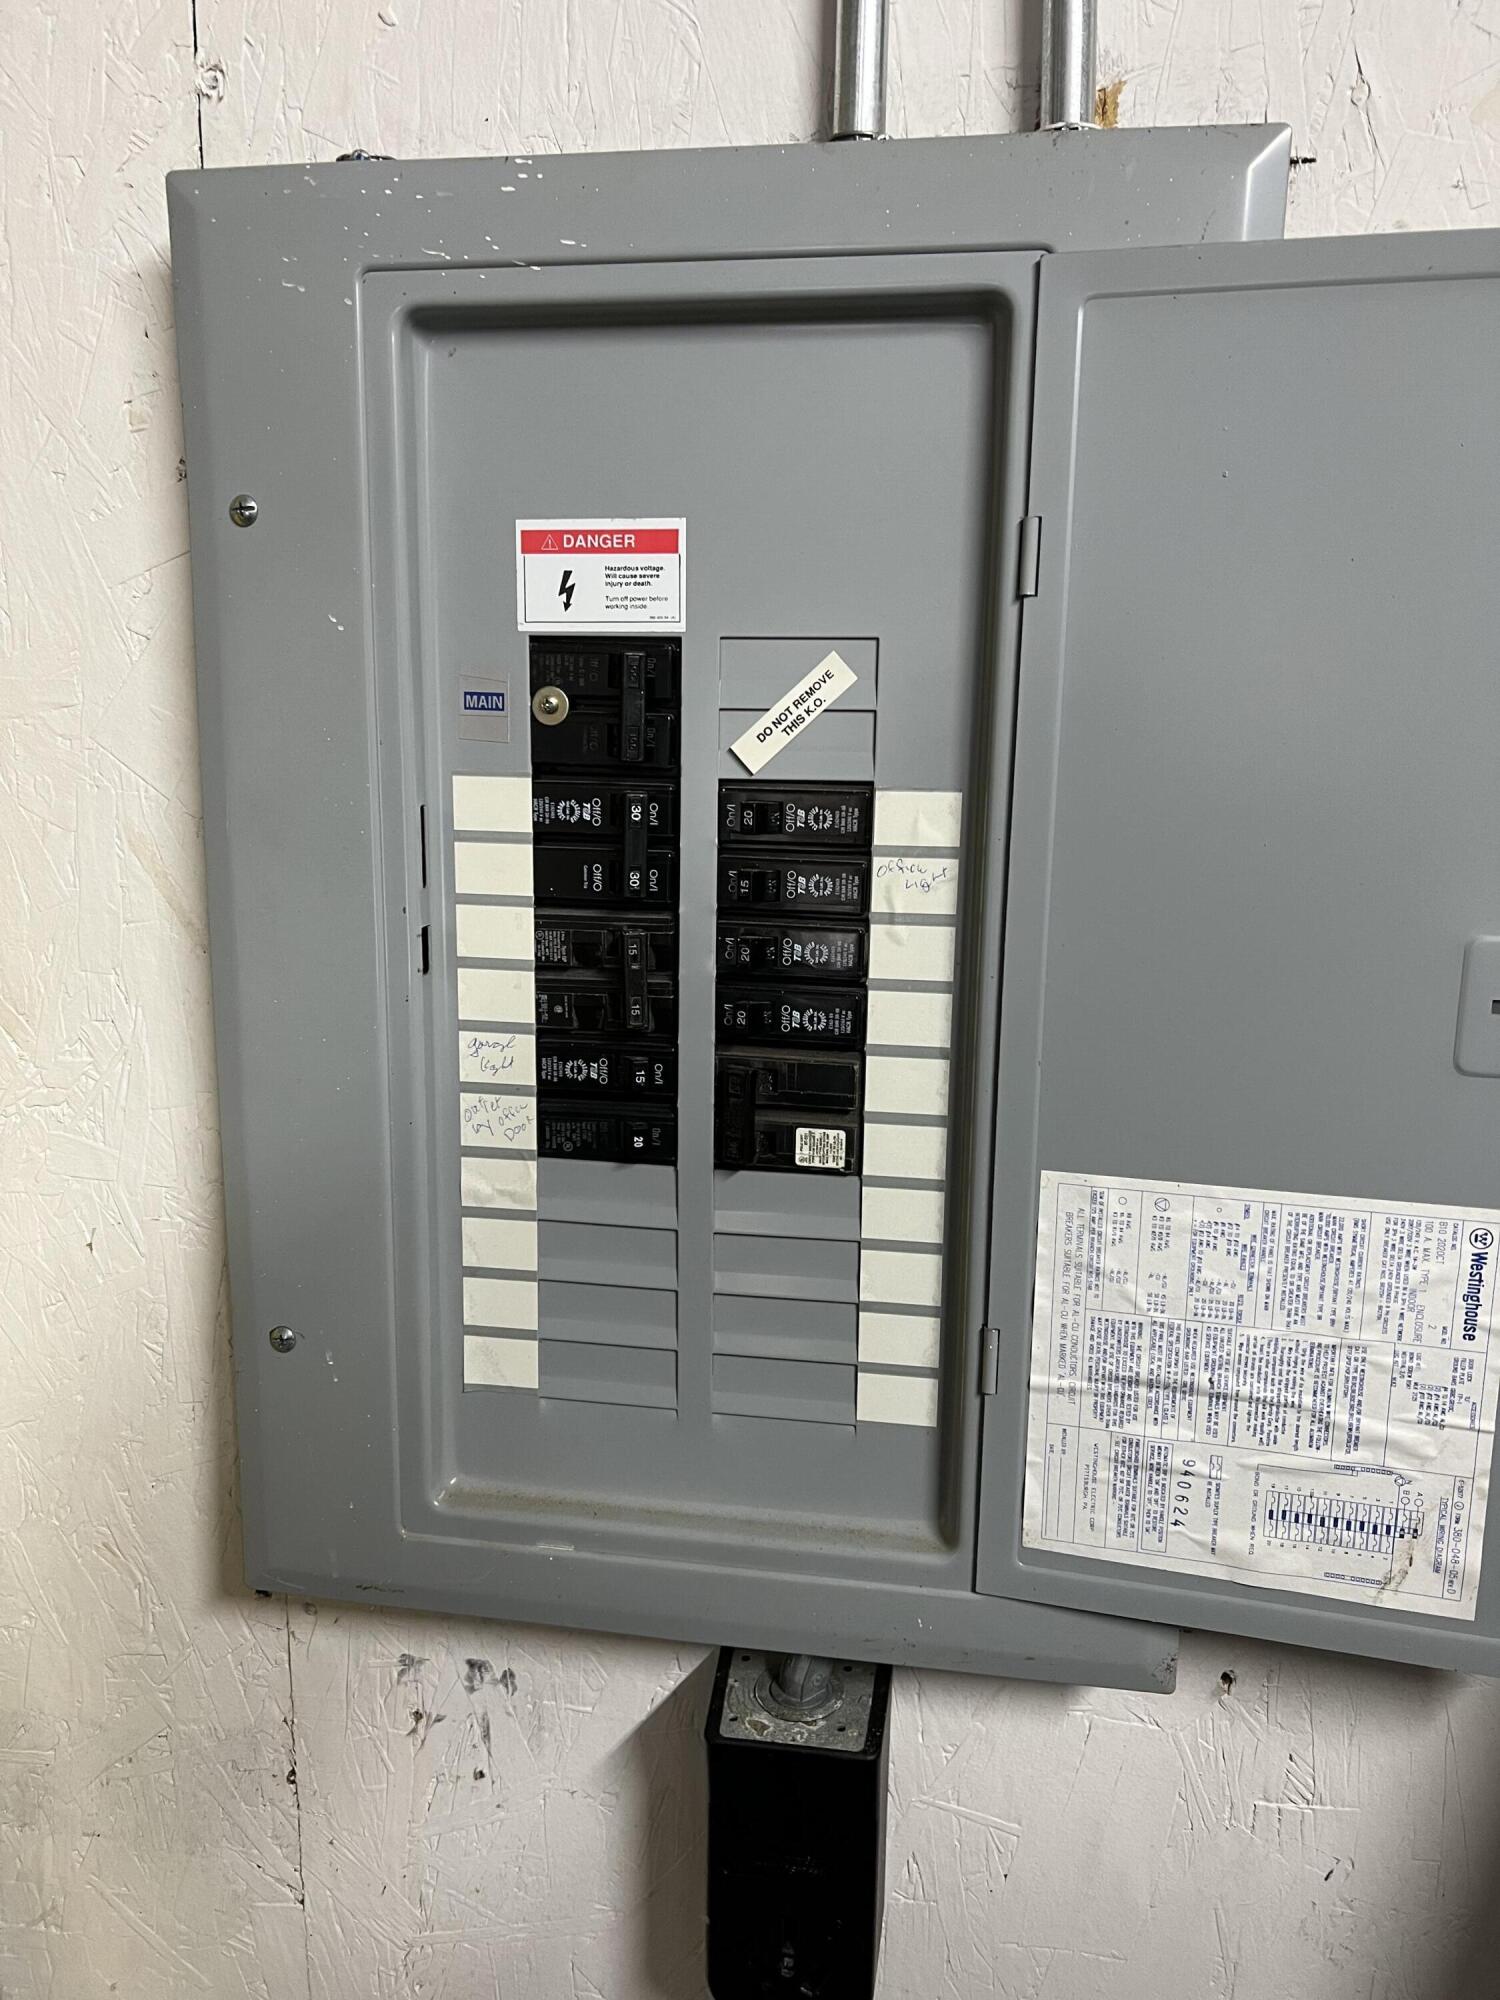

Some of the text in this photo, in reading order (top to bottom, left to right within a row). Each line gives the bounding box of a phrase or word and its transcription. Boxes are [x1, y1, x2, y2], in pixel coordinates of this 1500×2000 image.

[563, 534, 635, 548] DANGER
[466, 695, 502, 709] MAIN
[757, 670, 834, 742] DO NOT REMOVE
[781, 697, 826, 736] THIS K.O.
[592, 798, 601, 826] Off/O
[632, 805, 641, 820] 30
[650, 803, 658, 825] On/I
[727, 805, 735, 827] On/I
[744, 810, 753, 825] 20
[786, 804, 795, 832] Off/O
[593, 864, 602, 891] Off/O
[630, 872, 639, 886] 30
[650, 870, 658, 891] On/I
[728, 871, 737, 892] On/I
[741, 880, 749, 894] 15
[787, 871, 796, 898] Off/O
[629, 944, 637, 955] 15
[725, 937, 735, 959] On/I
[741, 947, 750, 961] 20
[782, 938, 792, 965] Off/O
[632, 1005, 639, 1015] 15
[724, 1004, 733, 1026] On/I
[737, 1011, 746, 1025] 20
[781, 1005, 791, 1032] Off/O
[599, 1058, 608, 1084] Off/O
[636, 1070, 645, 1083] 15
[654, 1064, 662, 1084] On/I
[634, 1137, 643, 1147] 20
[1077, 1207, 1085, 1218] ALL
[1064, 1211, 1073, 1245] BREAKERS
[1424, 1220, 1434, 1232] 100
[1075, 1223, 1084, 1257] TERMINALS
[1062, 1248, 1071, 1277] SUITABLE
[1073, 1261, 1082, 1290] SUITABLE
[1418, 1268, 1429, 1285] TYPE
[1061, 1281, 1069, 1294] FOR
[1458, 1249, 1488, 1342] Westinghouse
[1060, 1297, 1069, 1319] AL-CU
[1072, 1293, 1080, 1306] FOR
[1406, 1288, 1417, 1312] INDOOR
[1059, 1322, 1067, 1340] WHEN
[1071, 1309, 1079, 1332] AL-CU
[1412, 1304, 1425, 1343] ENCLOSURE
[1057, 1343, 1066, 1369] MARKED
[1067, 1381, 1076, 1405] CIRCUIT
[1091, 1442, 1099, 1484] WESTINGHOUSE
[1252, 1488, 1258, 1497] OR
[1433, 1496, 1448, 1574] TYPICAL WIRING DIAGRAM
[1447, 1526, 1462, 1579] 380-048-05
